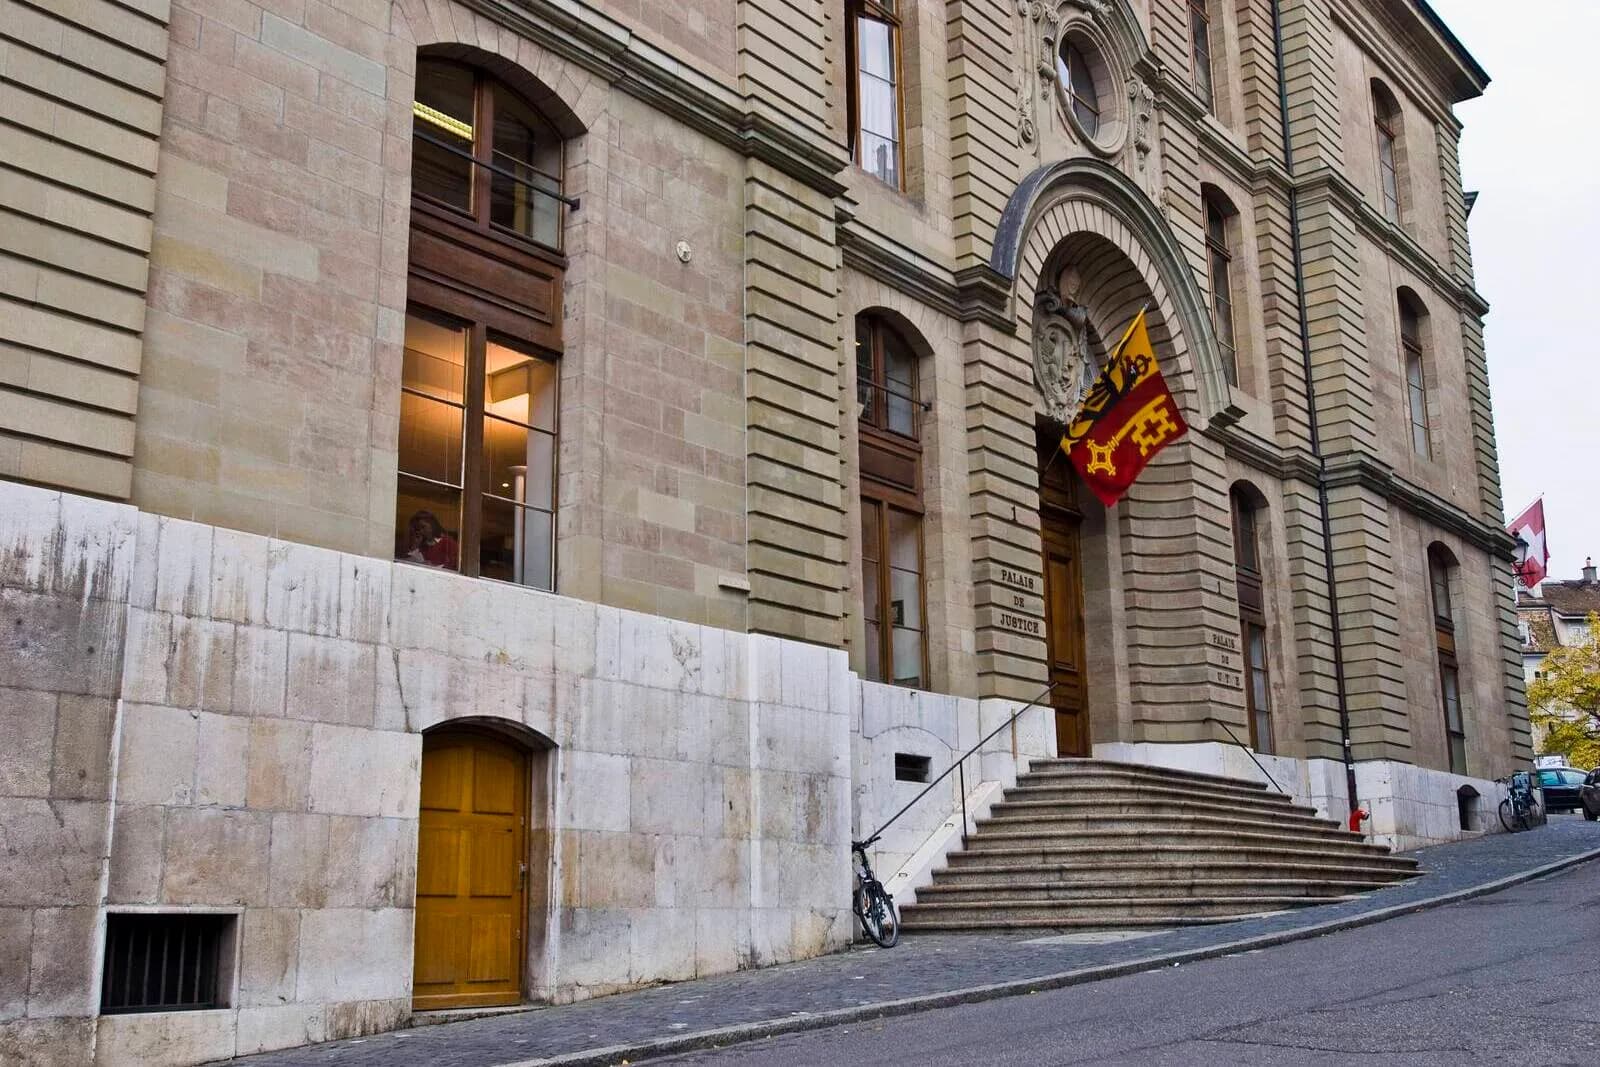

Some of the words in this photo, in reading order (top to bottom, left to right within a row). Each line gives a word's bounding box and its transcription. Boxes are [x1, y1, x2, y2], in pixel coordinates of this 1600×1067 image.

[1001, 569, 1034, 589] PALAIS
[1013, 595, 1025, 608] DE
[1000, 613, 1039, 634] JUSTICE
[1212, 633, 1235, 649] PALAIS
